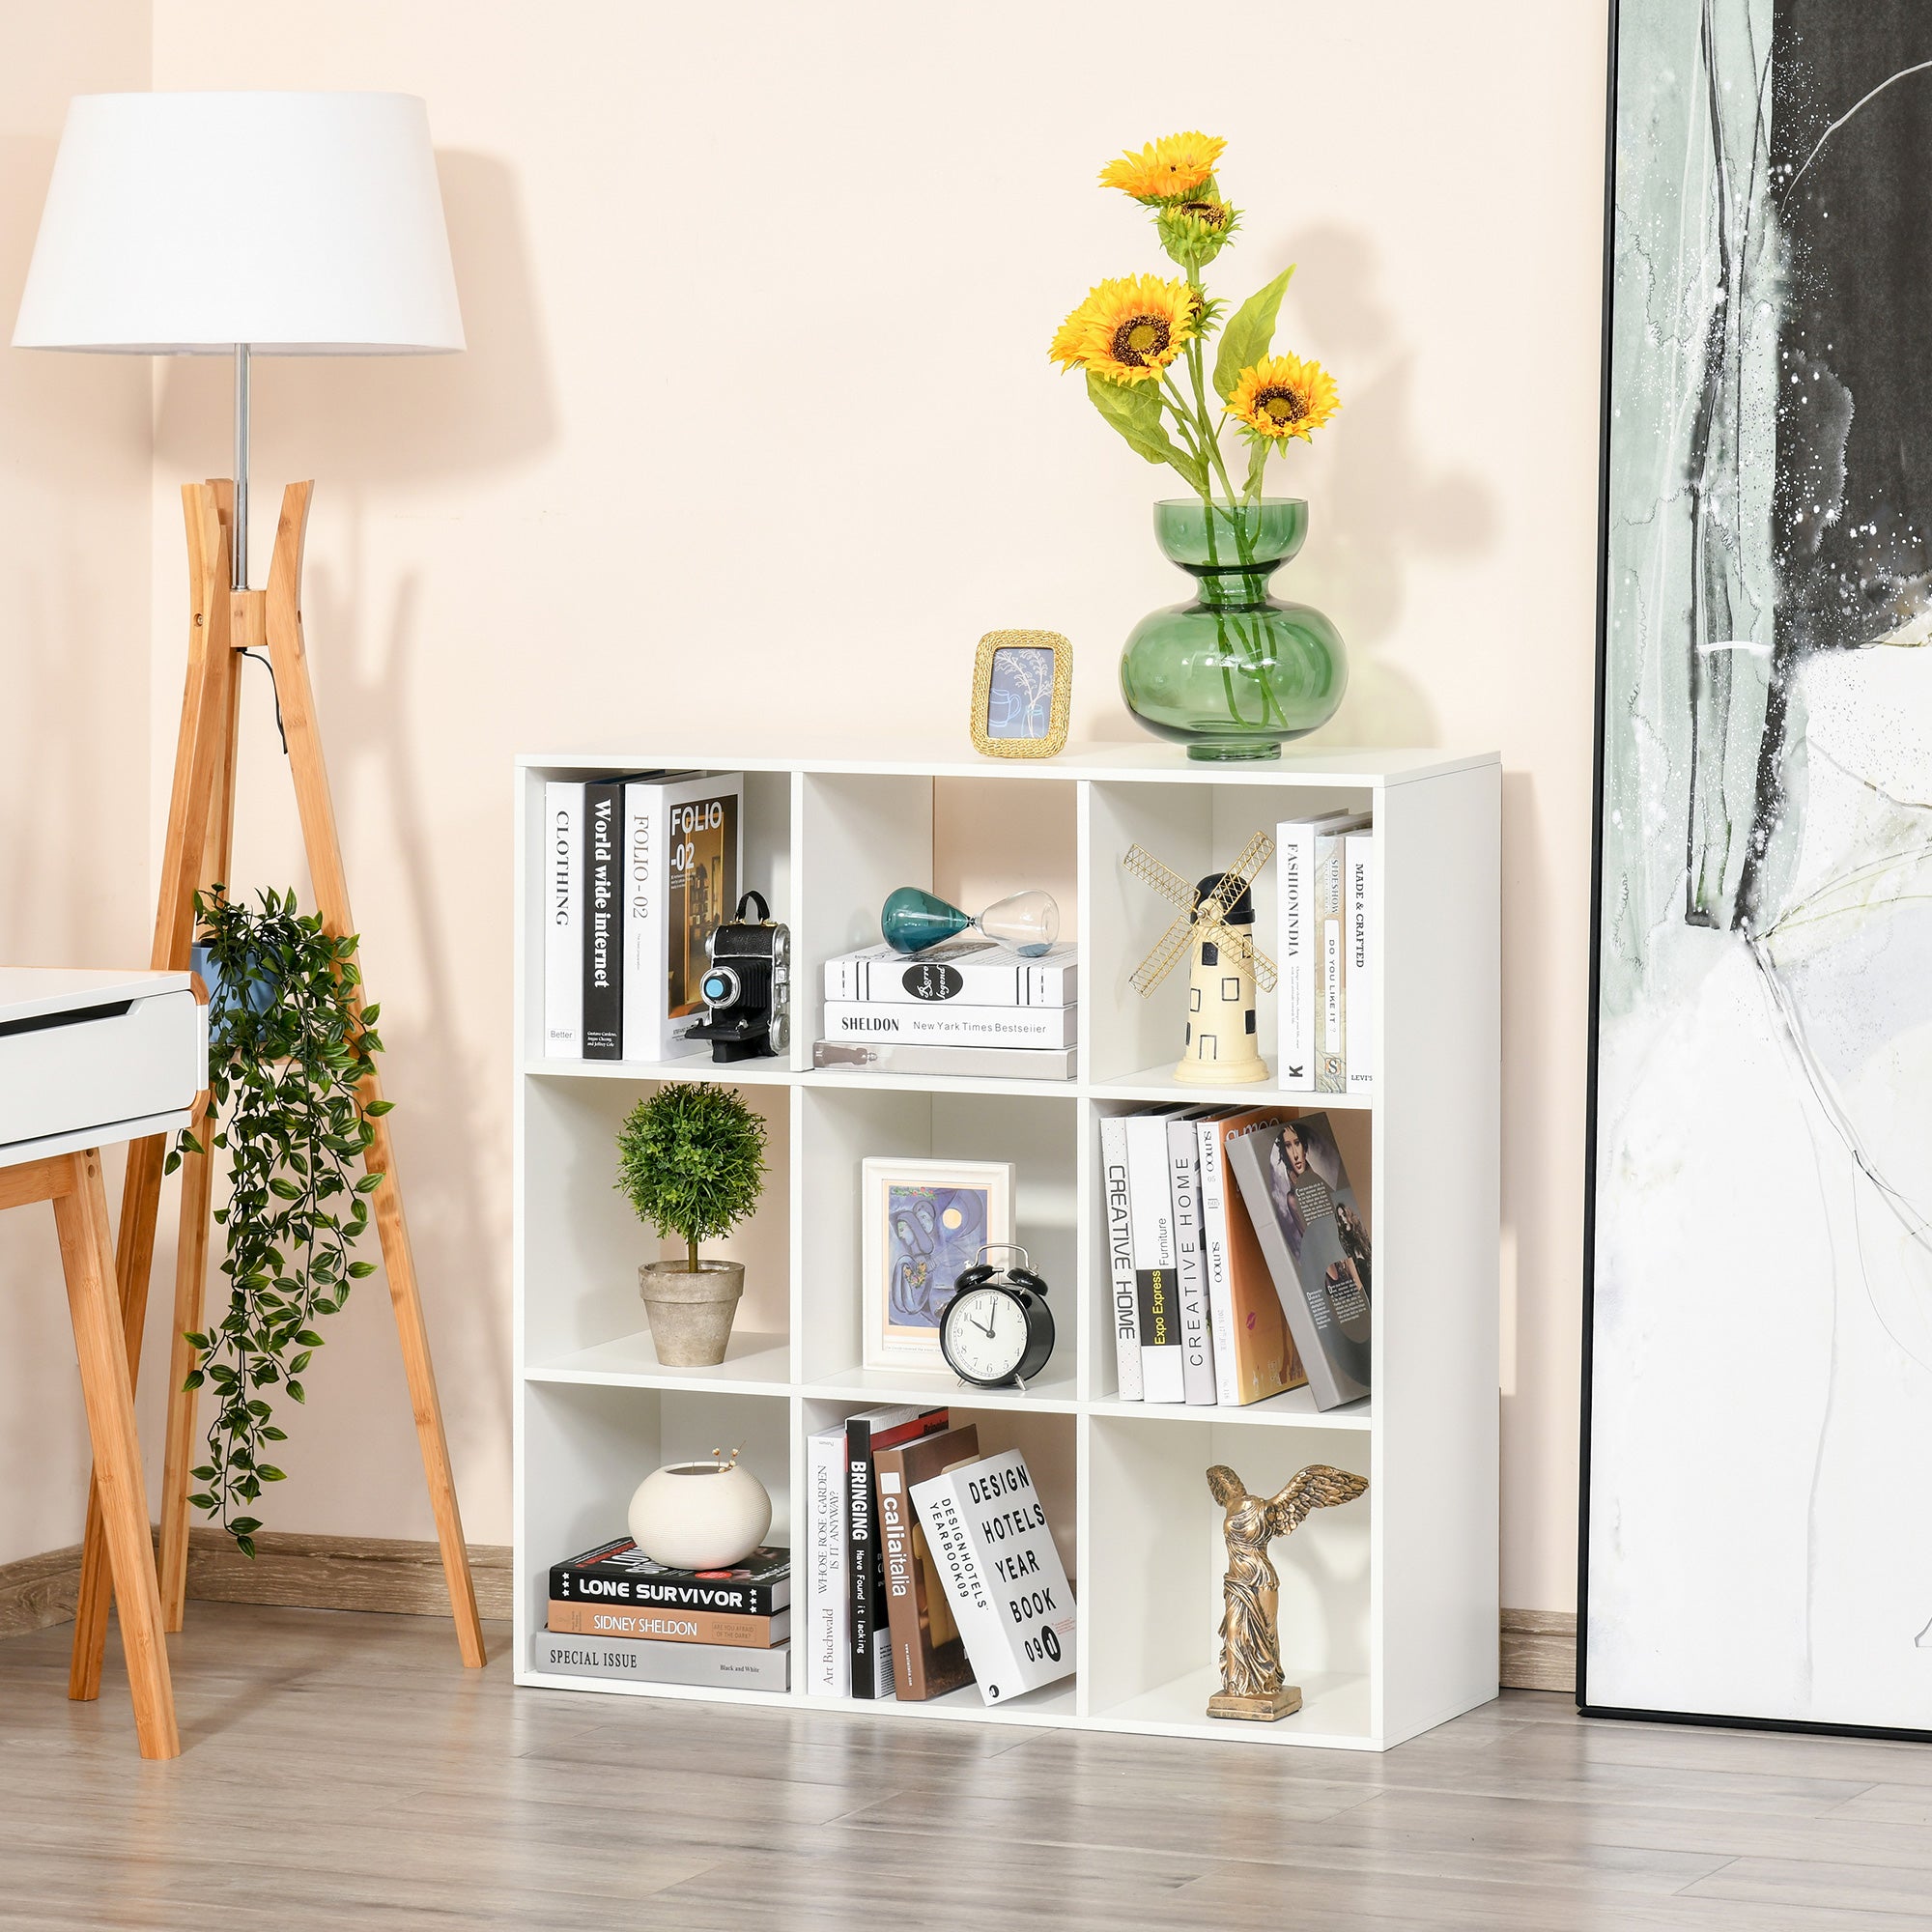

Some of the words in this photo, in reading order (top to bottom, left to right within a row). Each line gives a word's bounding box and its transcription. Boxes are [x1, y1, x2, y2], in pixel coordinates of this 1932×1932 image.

[594, 799, 611, 861] World
[671, 801, 723, 837] FOLIO
[633, 815, 649, 882] FOLIO
[556, 810, 570, 926] CLOTHING
[1355, 864, 1364, 899] MADE
[594, 865, 611, 909] wide
[1288, 843, 1299, 957] FASHIONINDIA
[1331, 859, 1340, 914] SIDESHOW
[633, 896, 649, 919] 02
[1355, 901, 1364, 911] &
[594, 912, 611, 988] internet
[1329, 939, 1336, 955] DO
[1355, 913, 1364, 968] CRAFTED
[841, 1016, 899, 1032] SHELDON
[913, 1021, 935, 1031] New
[962, 1021, 993, 1033] Times
[1329, 1011, 1336, 1024] IT
[551, 1030, 573, 1038] Better
[1289, 1065, 1304, 1078] K
[1176, 1157, 1192, 1226] HOME
[1109, 1165, 1134, 1270] CREATIVE
[1159, 1217, 1170, 1266] Furniture
[975, 1300, 982, 1310] 11
[1007, 1301, 1010, 1311] 1
[1152, 1270, 1166, 1315] Express
[1181, 1241, 1204, 1367] CREATIVE
[1017, 1314, 1023, 1323] 2
[1116, 1281, 1136, 1340] HOME
[957, 1328, 963, 1337] 9
[1154, 1317, 1166, 1345] Expo
[961, 1345, 967, 1353] 8
[974, 1357, 979, 1367] 7
[986, 1363, 993, 1373] 6
[1003, 1359, 1009, 1369] 5
[817, 1465, 828, 1514] GARDEN
[969, 1464, 1030, 1505] DESIGN
[850, 1461, 868, 1541] BRINGING
[829, 1491, 839, 1542] ANYWAY?
[981, 1504, 1046, 1544] HOTELS
[817, 1519, 828, 1548] ROSE
[883, 1497, 910, 1597] caliaitalia
[829, 1546, 839, 1556] IT
[829, 1560, 839, 1570] IS
[856, 1549, 865, 1571] Have
[817, 1550, 828, 1594] WHOSE
[995, 1549, 1040, 1583] YEAR
[580, 1578, 630, 1598] LONE
[636, 1583, 743, 1607] SURVIVOR
[857, 1574, 866, 1600] Found
[857, 1605, 866, 1614] it
[1009, 1587, 1057, 1624] BOOK
[593, 1614, 637, 1632] SIDNEY
[639, 1618, 697, 1636] SHELDON
[822, 1608, 834, 1663] Buchwald
[856, 1620, 867, 1654] lacking
[551, 1649, 599, 1666] SPECIAL
[604, 1652, 638, 1668] ISSUE
[1024, 1636, 1044, 1662] 09
[822, 1666, 834, 1686] Art
